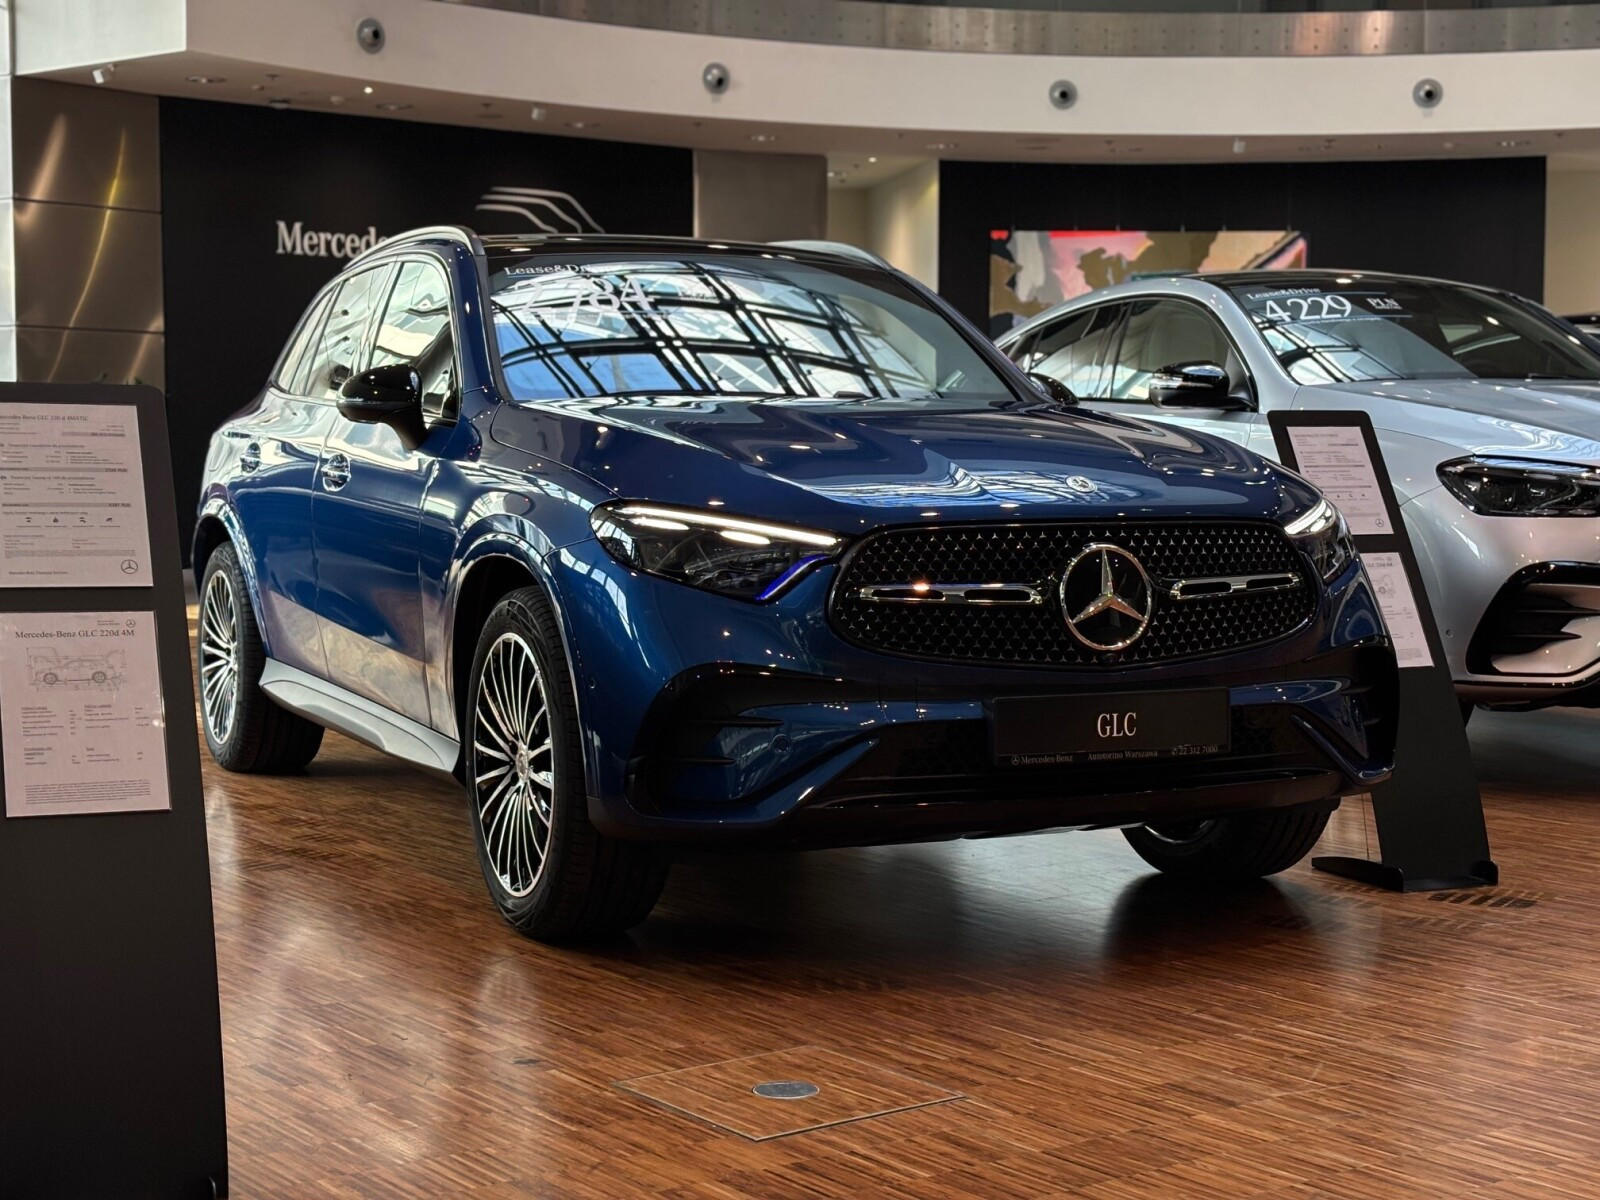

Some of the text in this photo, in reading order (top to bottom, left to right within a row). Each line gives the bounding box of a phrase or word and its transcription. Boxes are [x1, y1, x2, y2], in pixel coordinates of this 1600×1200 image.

[1246, 287, 1322, 300] Lease&Drive
[15, 629, 135, 639] Mercedes-Benz GLC 220d 4M
[1096, 712, 1137, 738] GLC
[1087, 751, 1123, 762] Autotorino
[1125, 749, 1158, 759] Warszawa
